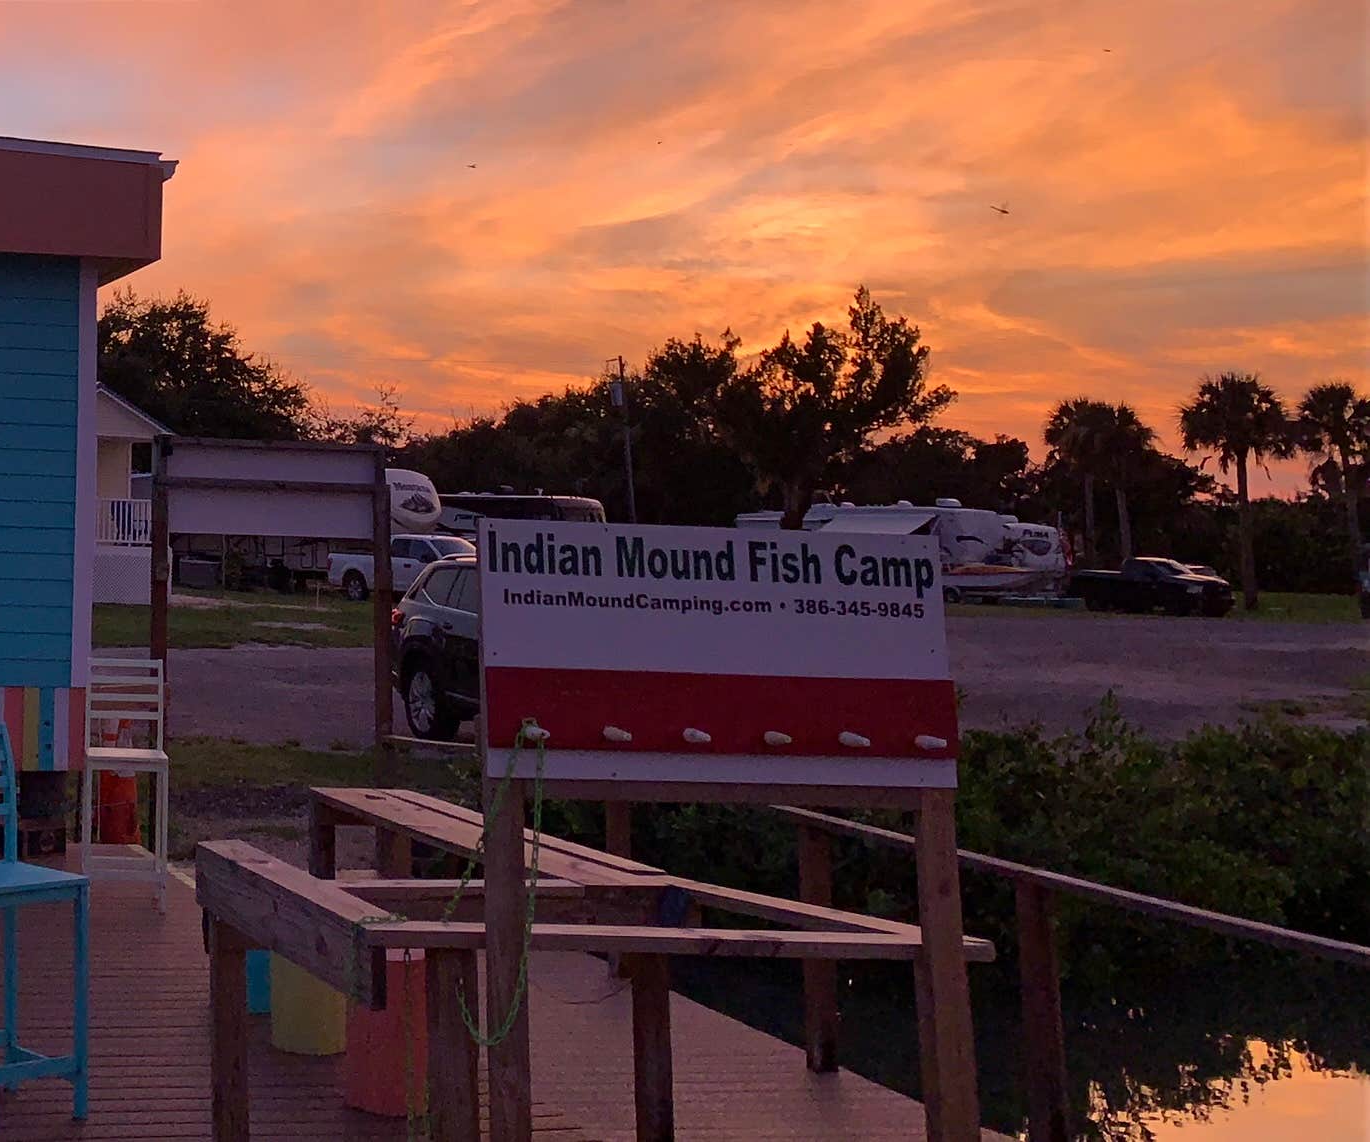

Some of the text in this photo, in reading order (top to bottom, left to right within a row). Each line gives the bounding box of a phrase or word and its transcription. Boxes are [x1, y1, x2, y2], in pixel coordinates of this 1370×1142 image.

[488, 530, 934, 598] Indian Mound Fish Camp
[503, 588, 925, 619] IndianMoundCamping.com 386-345-9845
